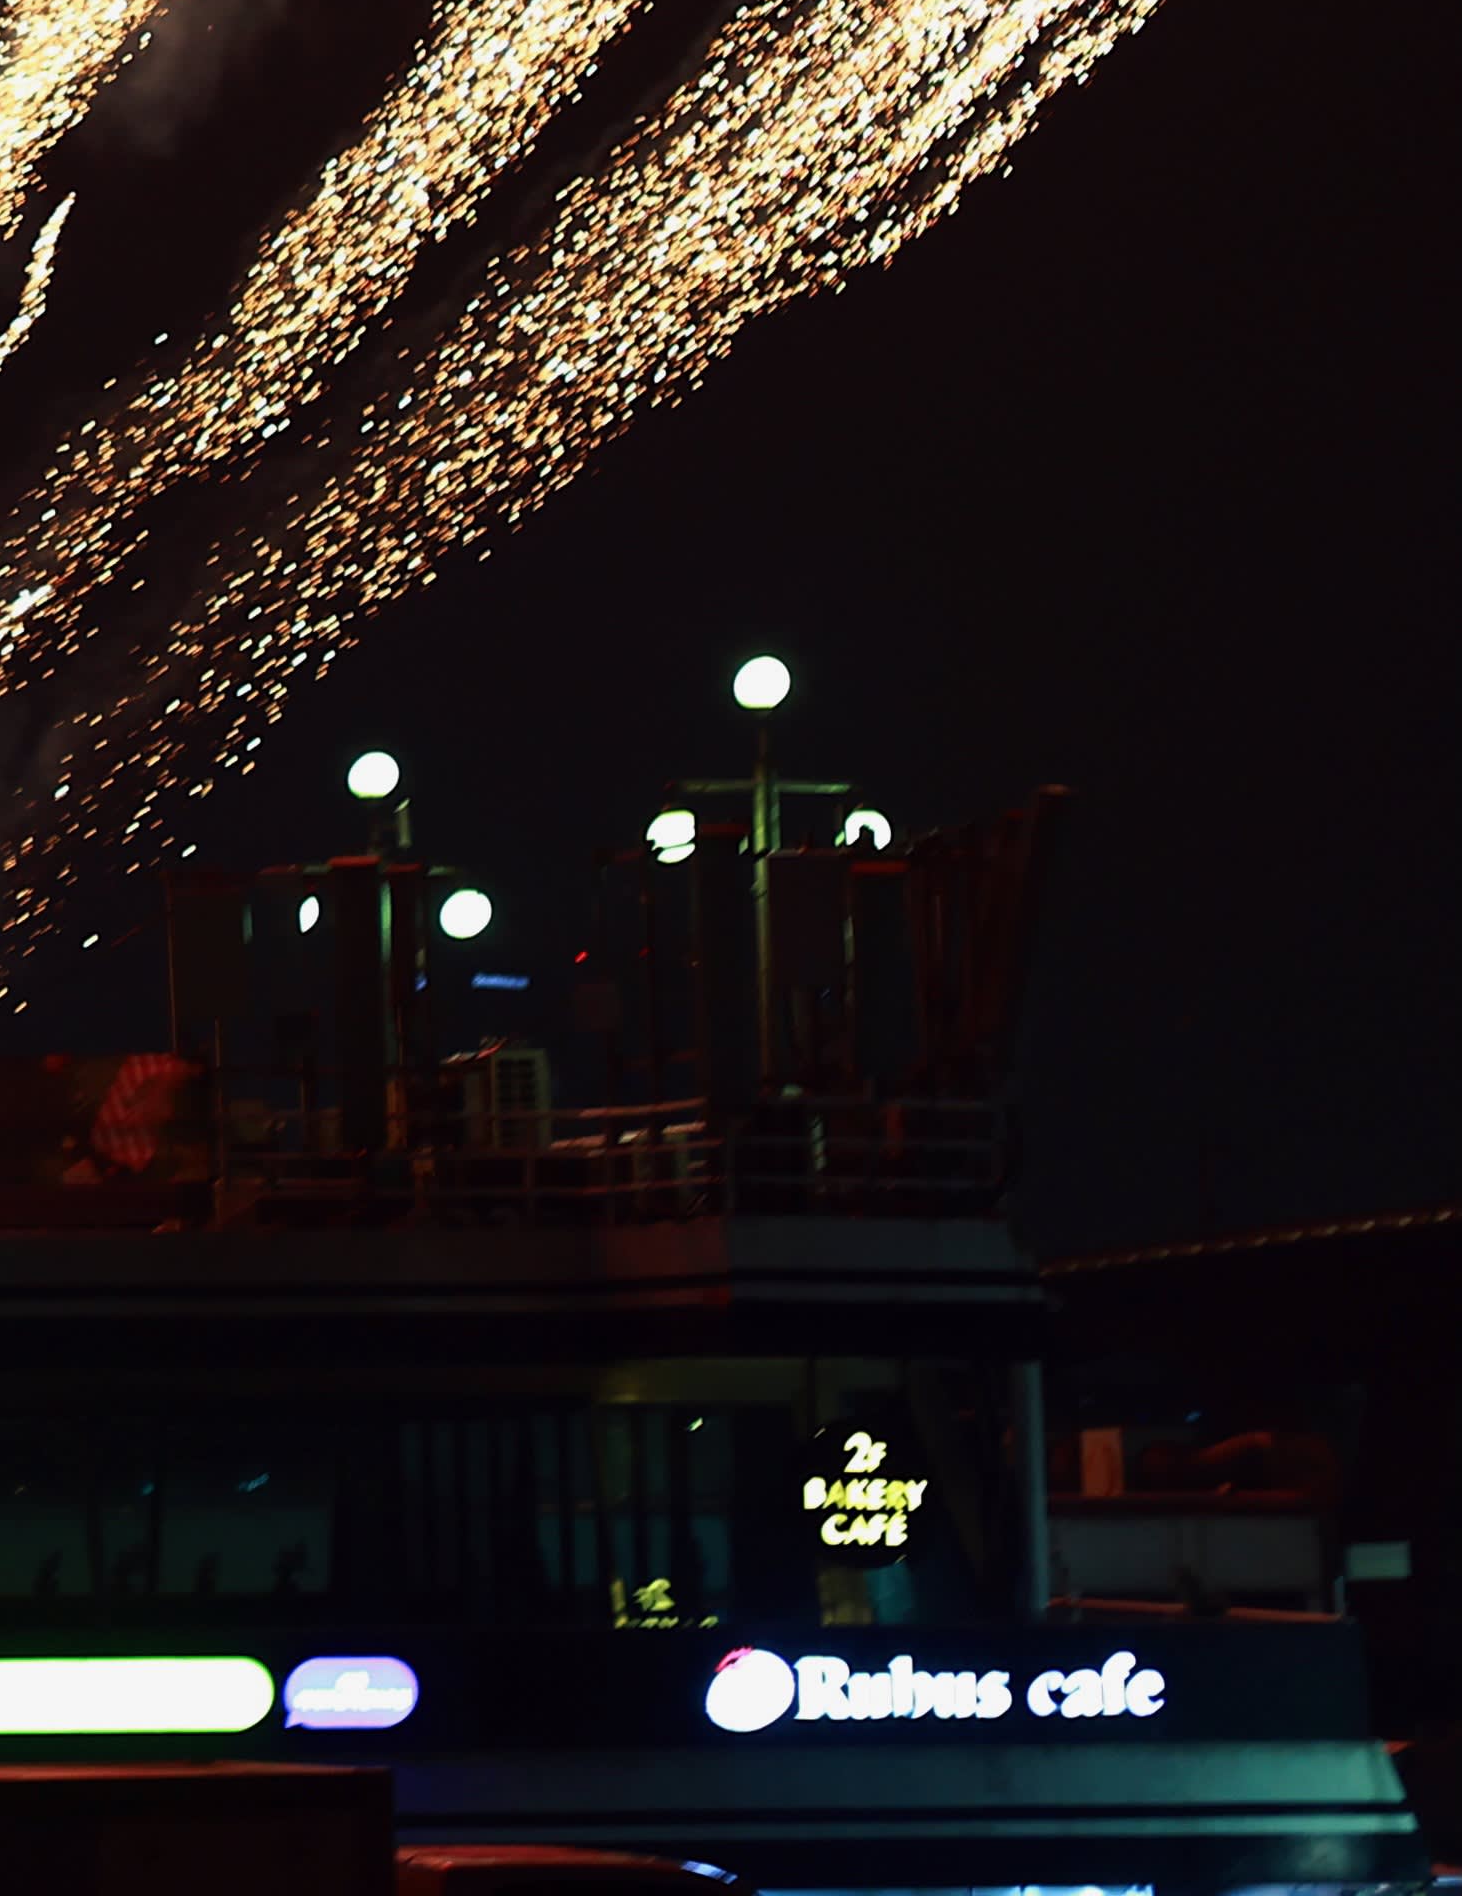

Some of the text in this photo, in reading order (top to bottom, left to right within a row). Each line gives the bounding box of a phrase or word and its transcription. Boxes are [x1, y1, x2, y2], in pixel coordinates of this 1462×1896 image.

[803, 1476, 929, 1512] BAKERY
[793, 1650, 1166, 1721] Rubus cafe
